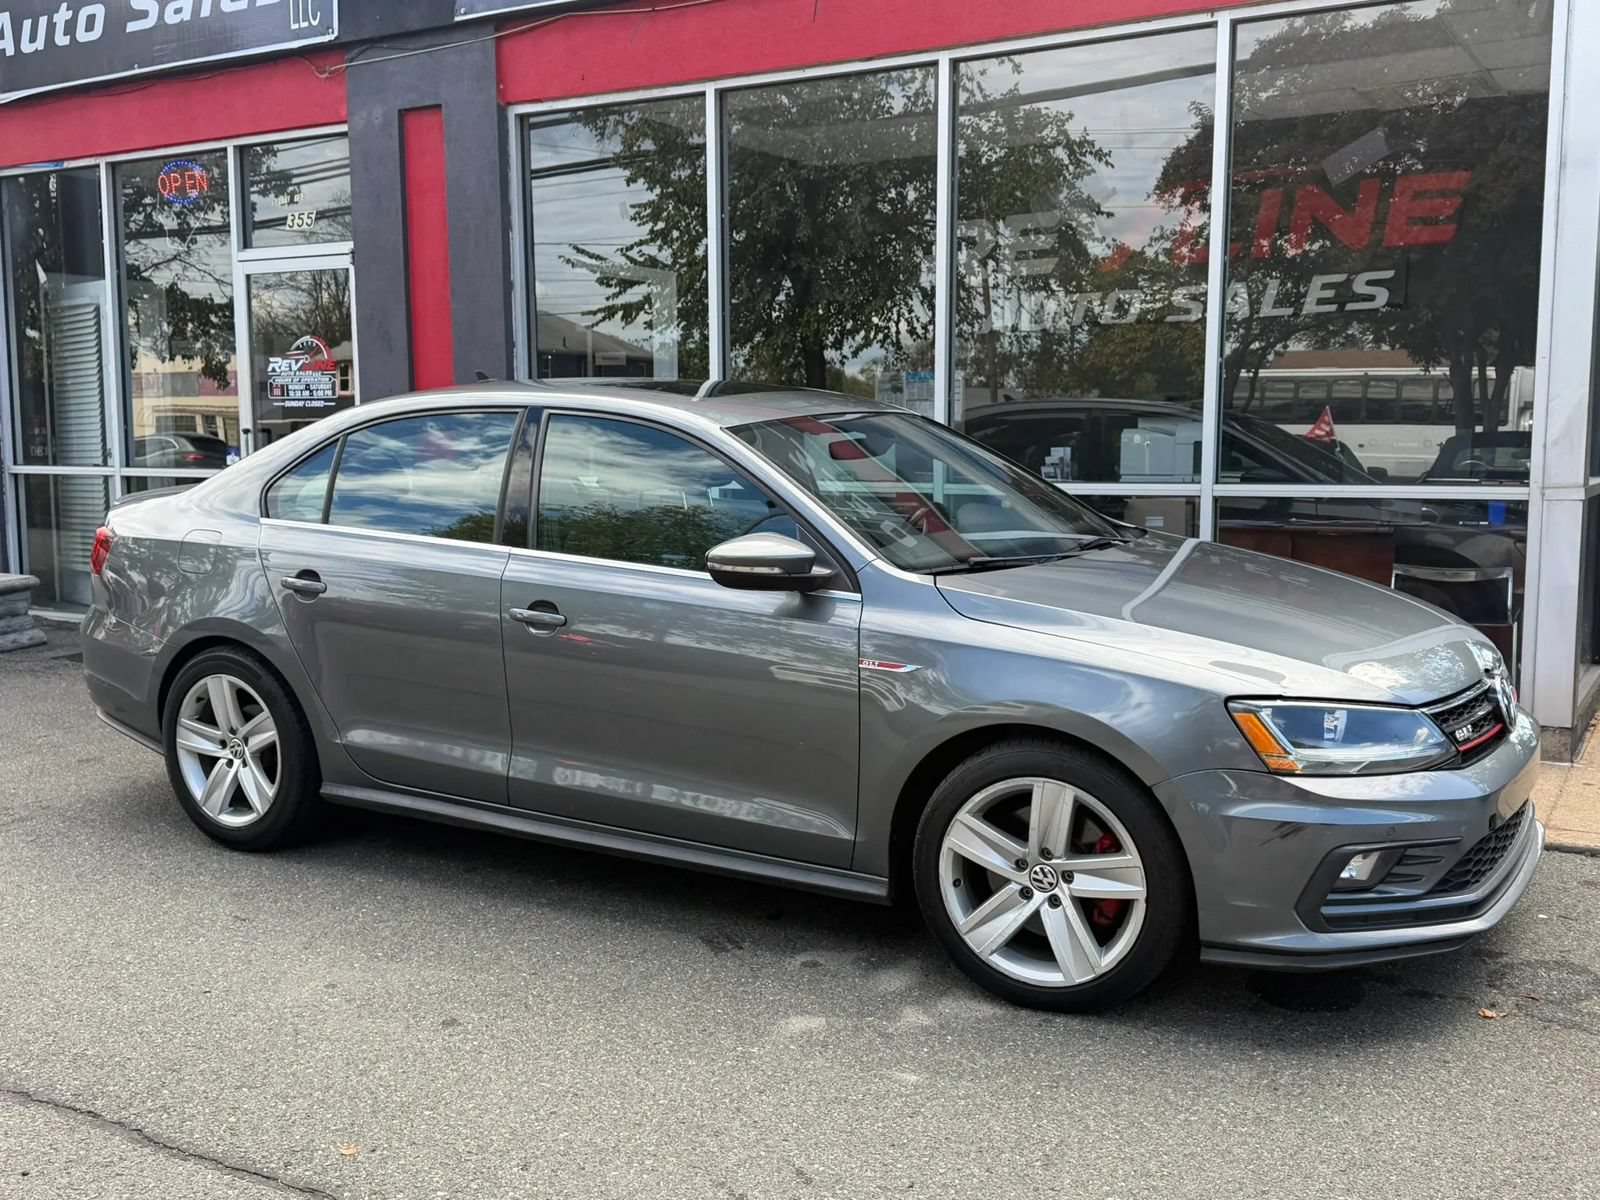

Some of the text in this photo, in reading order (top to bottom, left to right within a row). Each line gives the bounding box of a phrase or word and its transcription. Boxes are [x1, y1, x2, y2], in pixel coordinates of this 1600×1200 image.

[158, 171, 208, 195] OPEN
[287, 211, 315, 229] 355
[267, 357, 304, 372] REV
